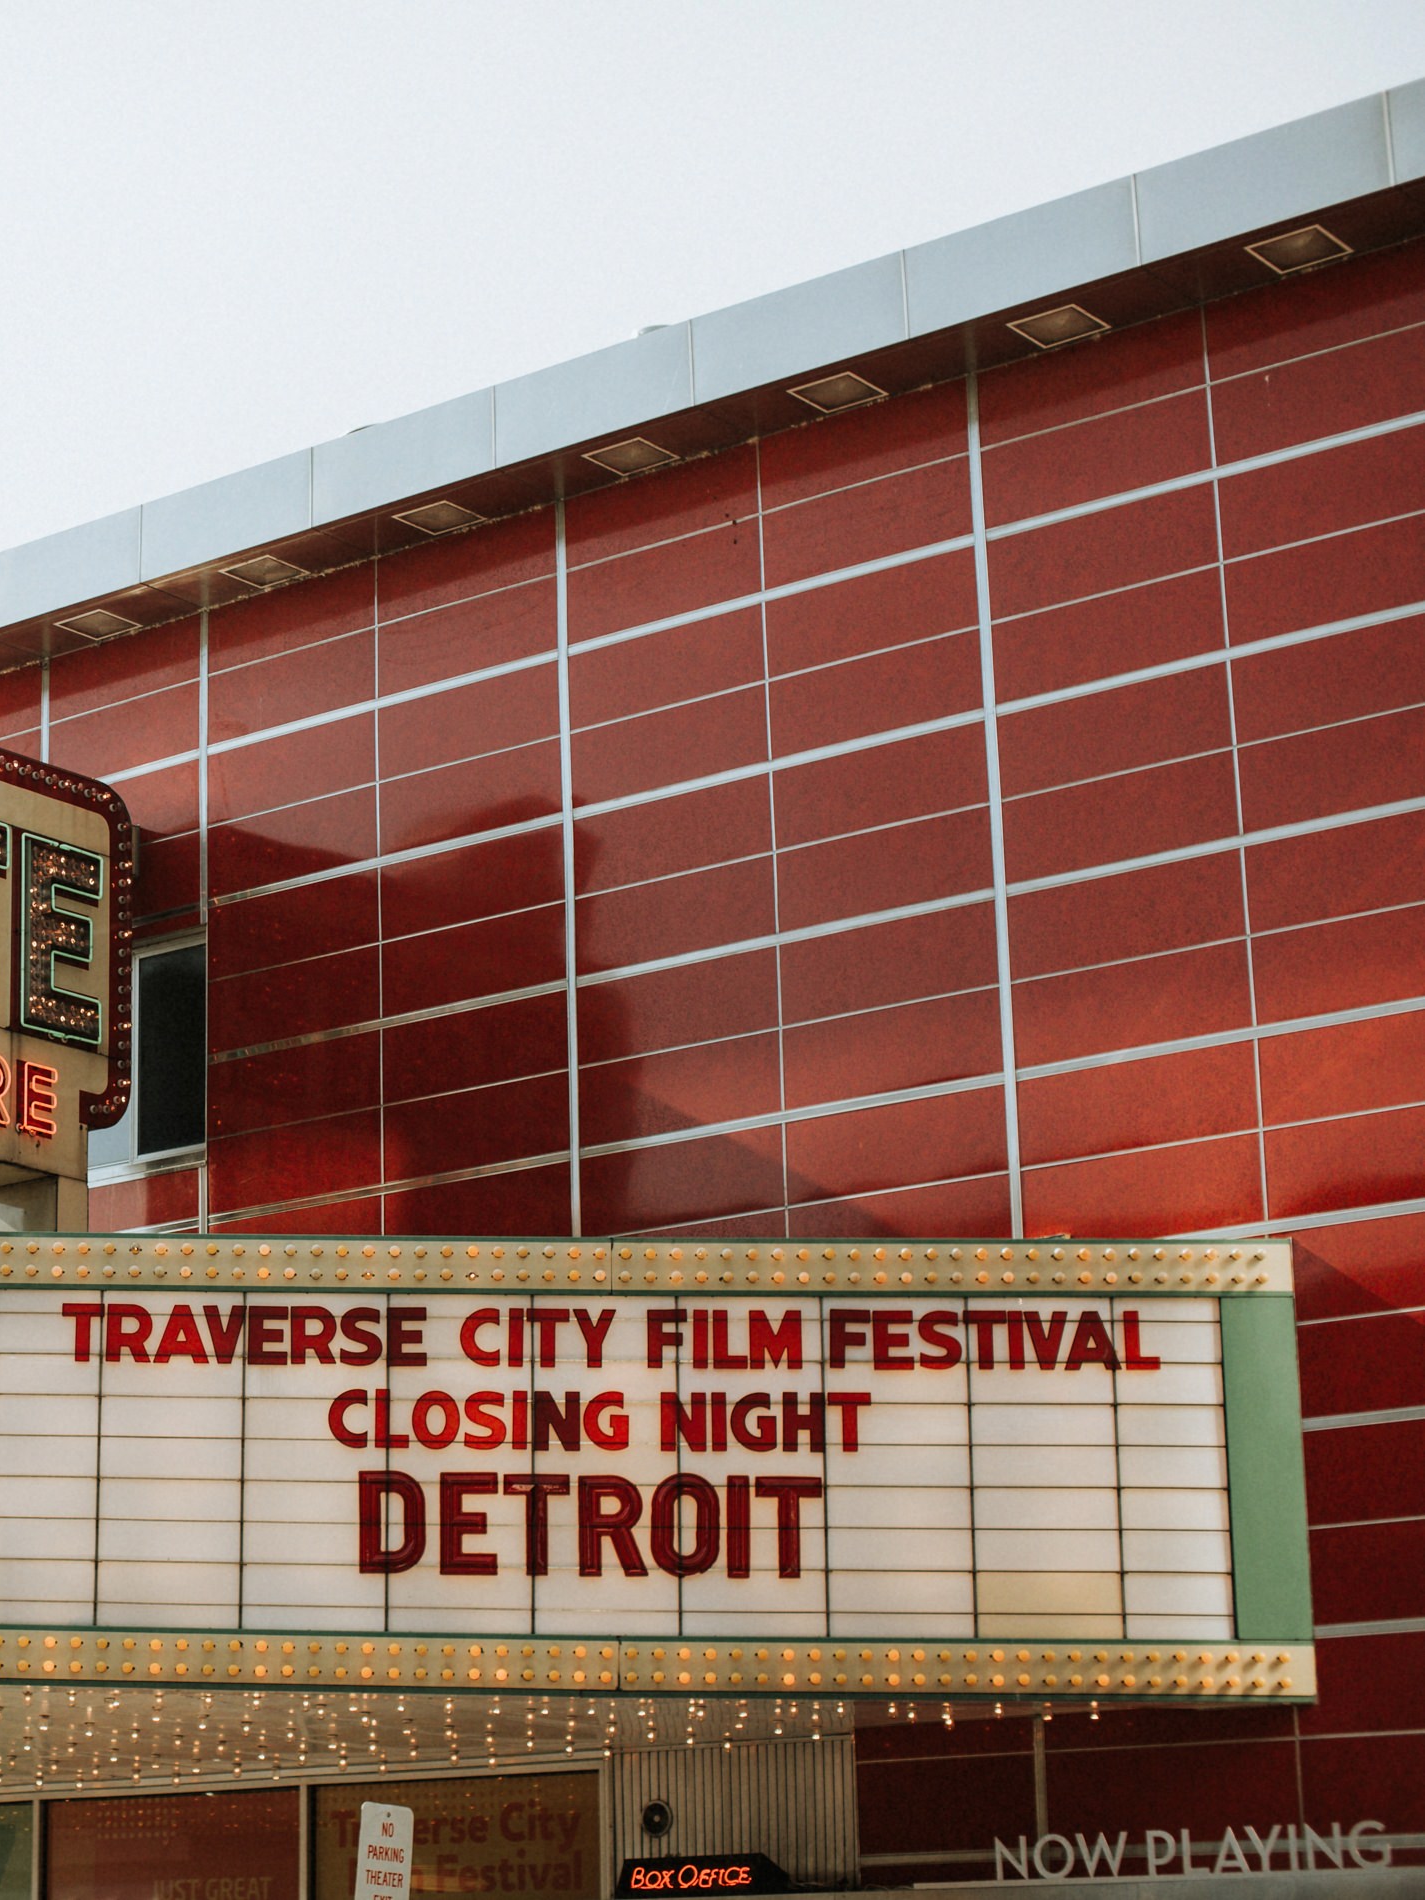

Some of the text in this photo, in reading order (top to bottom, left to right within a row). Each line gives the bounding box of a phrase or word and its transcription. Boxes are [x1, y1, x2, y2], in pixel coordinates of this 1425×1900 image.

[62, 1303, 1161, 1371] TRAVERSE CITY FILM FESTIVAL
[328, 1389, 872, 1452] CLOSING NIGHT
[359, 1470, 823, 1579] DETROIT
[381, 1822, 394, 1838] NO
[499, 1798, 582, 1852] City
[994, 1820, 1393, 1881] NOW PLAYING
[365, 1869, 404, 1889] THEATER
[366, 1844, 405, 1864] PARKING
[435, 1848, 583, 1894] Festival
